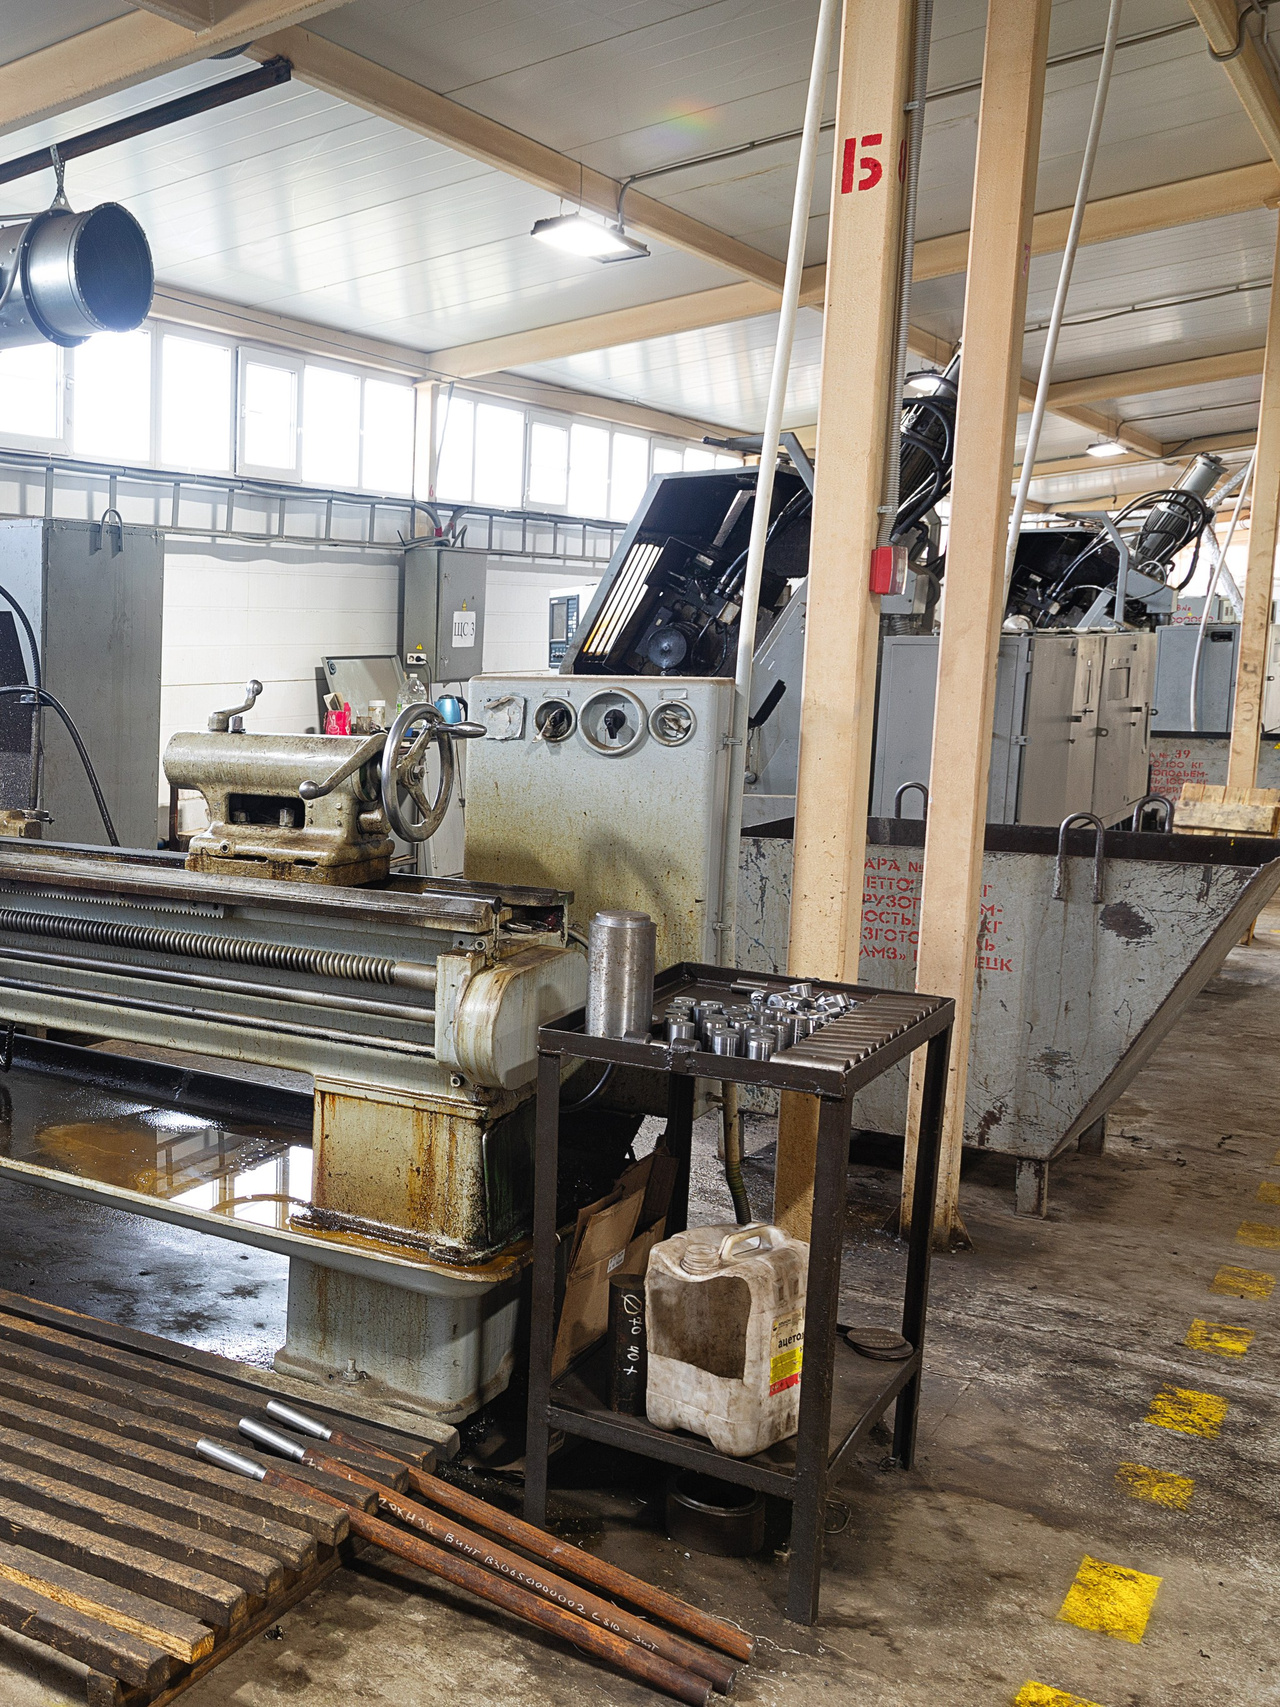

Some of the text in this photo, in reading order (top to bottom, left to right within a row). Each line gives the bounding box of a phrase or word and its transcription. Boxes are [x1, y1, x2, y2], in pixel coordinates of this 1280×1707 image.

[841, 133, 883, 194] Б
[429, 484, 434, 497] 6
[454, 622, 475, 638] ЩС 3
[1175, 749, 1191, 759] 39
[1166, 761, 1185, 769] 100
[864, 858, 900, 872] АРА
[863, 876, 993, 897] ЕТТО: Г
[862, 893, 921, 910] РУЗО
[861, 909, 916, 926] ОСТЬ:
[860, 926, 920, 944] ЗГОТО
[975, 955, 1013, 972] ЕЦК
